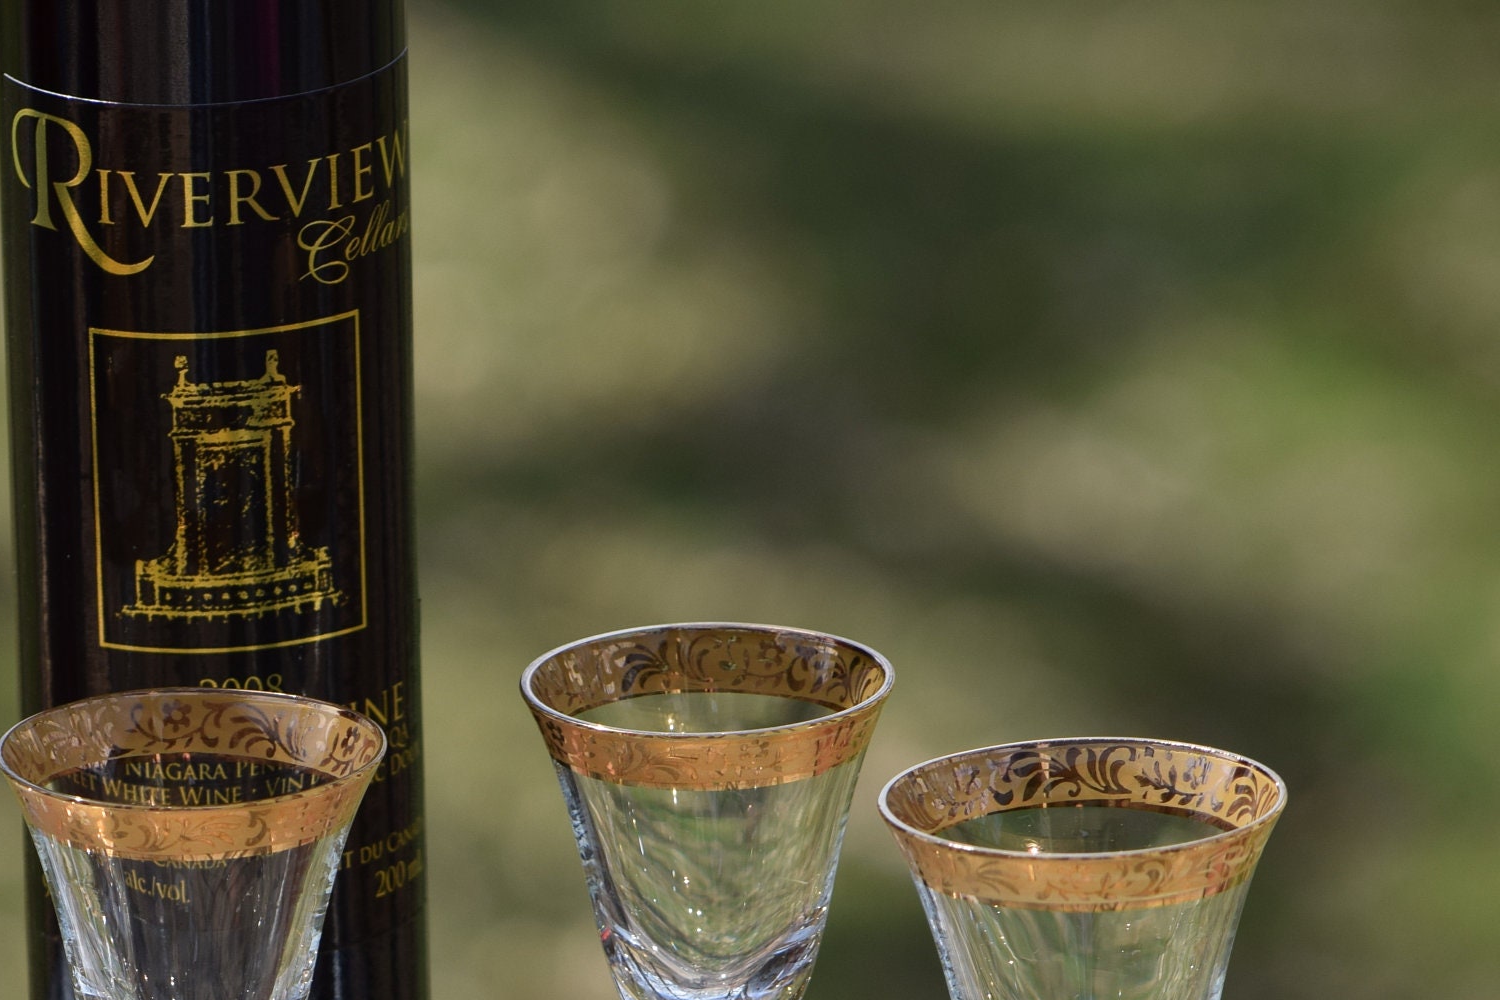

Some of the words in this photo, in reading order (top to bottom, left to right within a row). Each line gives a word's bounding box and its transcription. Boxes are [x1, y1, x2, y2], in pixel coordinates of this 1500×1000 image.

[11, 107, 407, 276] RIVERVIEW
[125, 760, 228, 782] NIAGARA
[102, 777, 171, 807] WHITE
[178, 783, 243, 808] WINE
[265, 772, 303, 797] VIN
[360, 839, 383, 865] DU
[374, 860, 405, 898] 200
